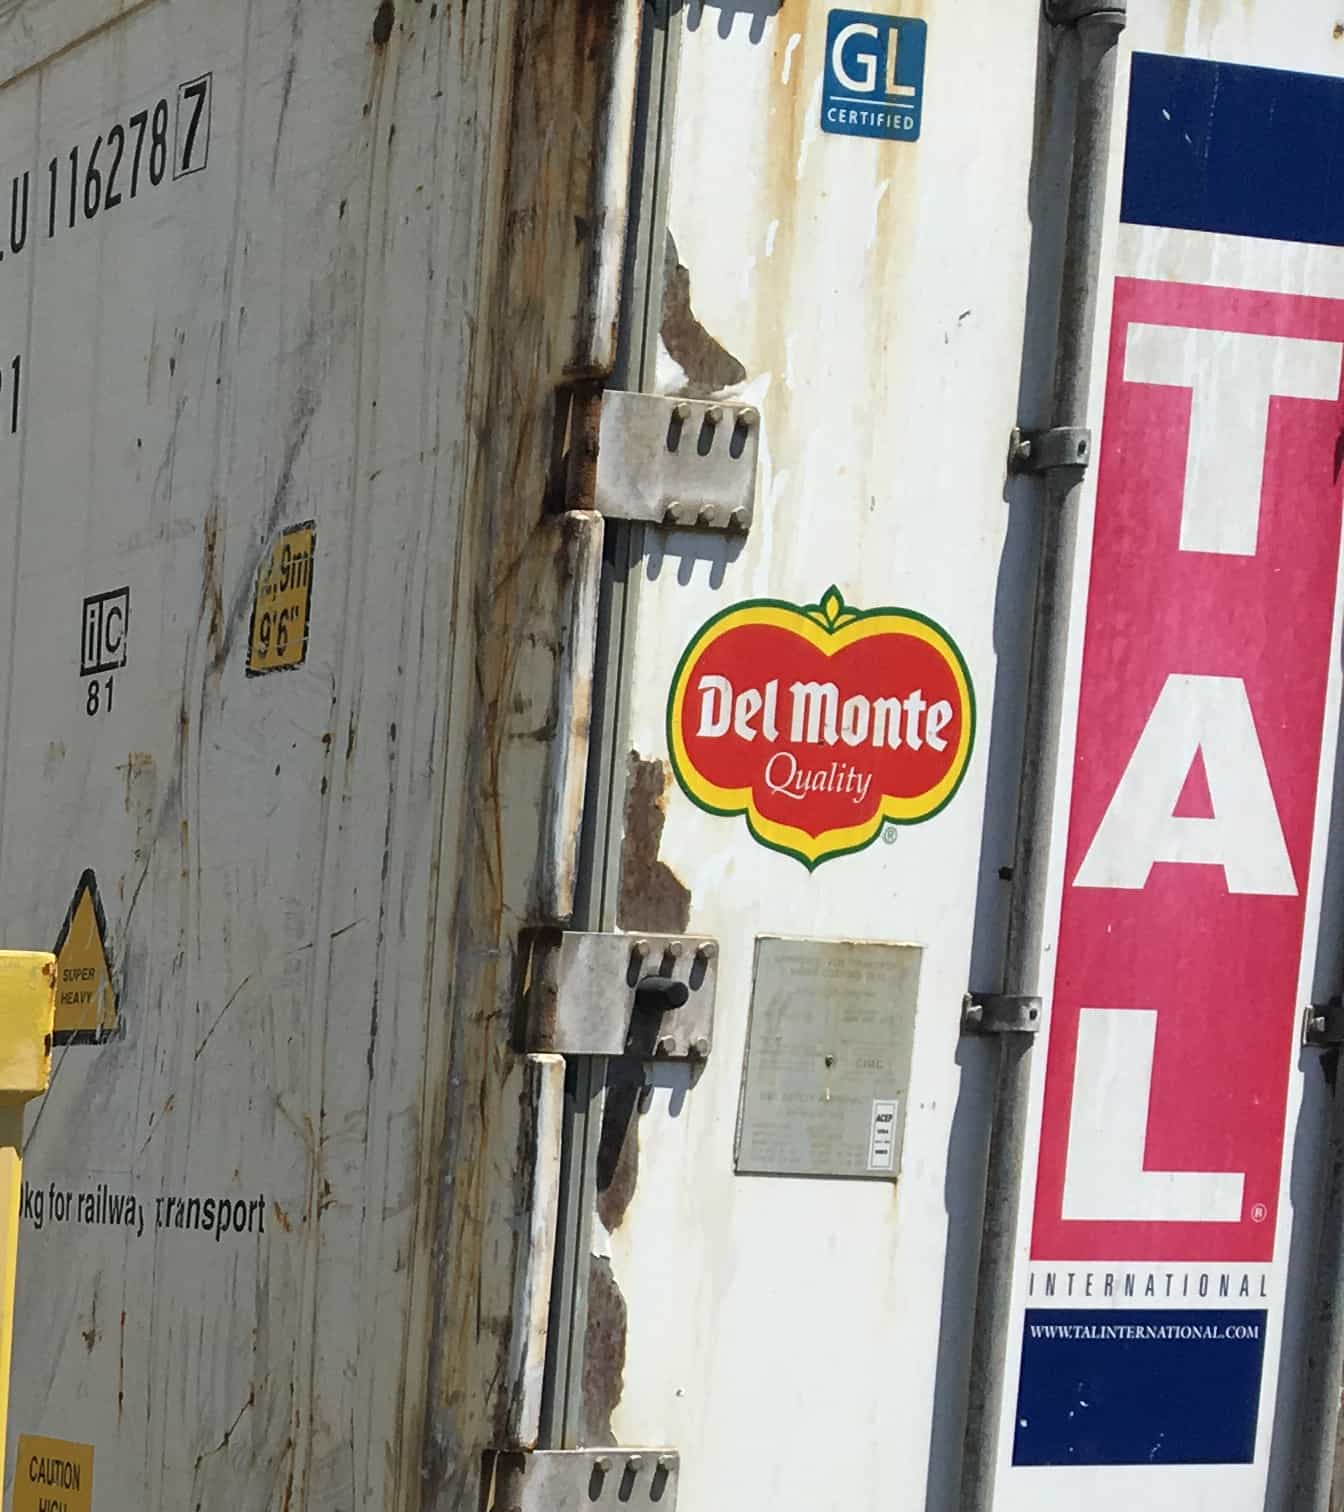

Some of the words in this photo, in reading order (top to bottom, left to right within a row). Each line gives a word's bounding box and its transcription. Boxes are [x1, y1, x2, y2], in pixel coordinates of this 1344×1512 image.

[831, 21, 917, 98] GL
[826, 106, 915, 132] CERTIFIED
[47, 98, 168, 239] 116278
[181, 81, 208, 172] 7
[86, 675, 114, 716] 81
[696, 674, 780, 743] Del
[789, 679, 953, 752] Monte
[763, 750, 873, 802] Quality
[62, 967, 97, 982] SUPER
[60, 991, 93, 1005] HEAVY
[19, 1181, 44, 1230] kg
[50, 1182, 73, 1222] for
[1028, 1272, 1269, 1299] INTERNATIONAL
[1029, 1323, 1260, 1342] WWW.TALINTERNATIONAL.COM
[27, 1454, 82, 1493] CAUTION
